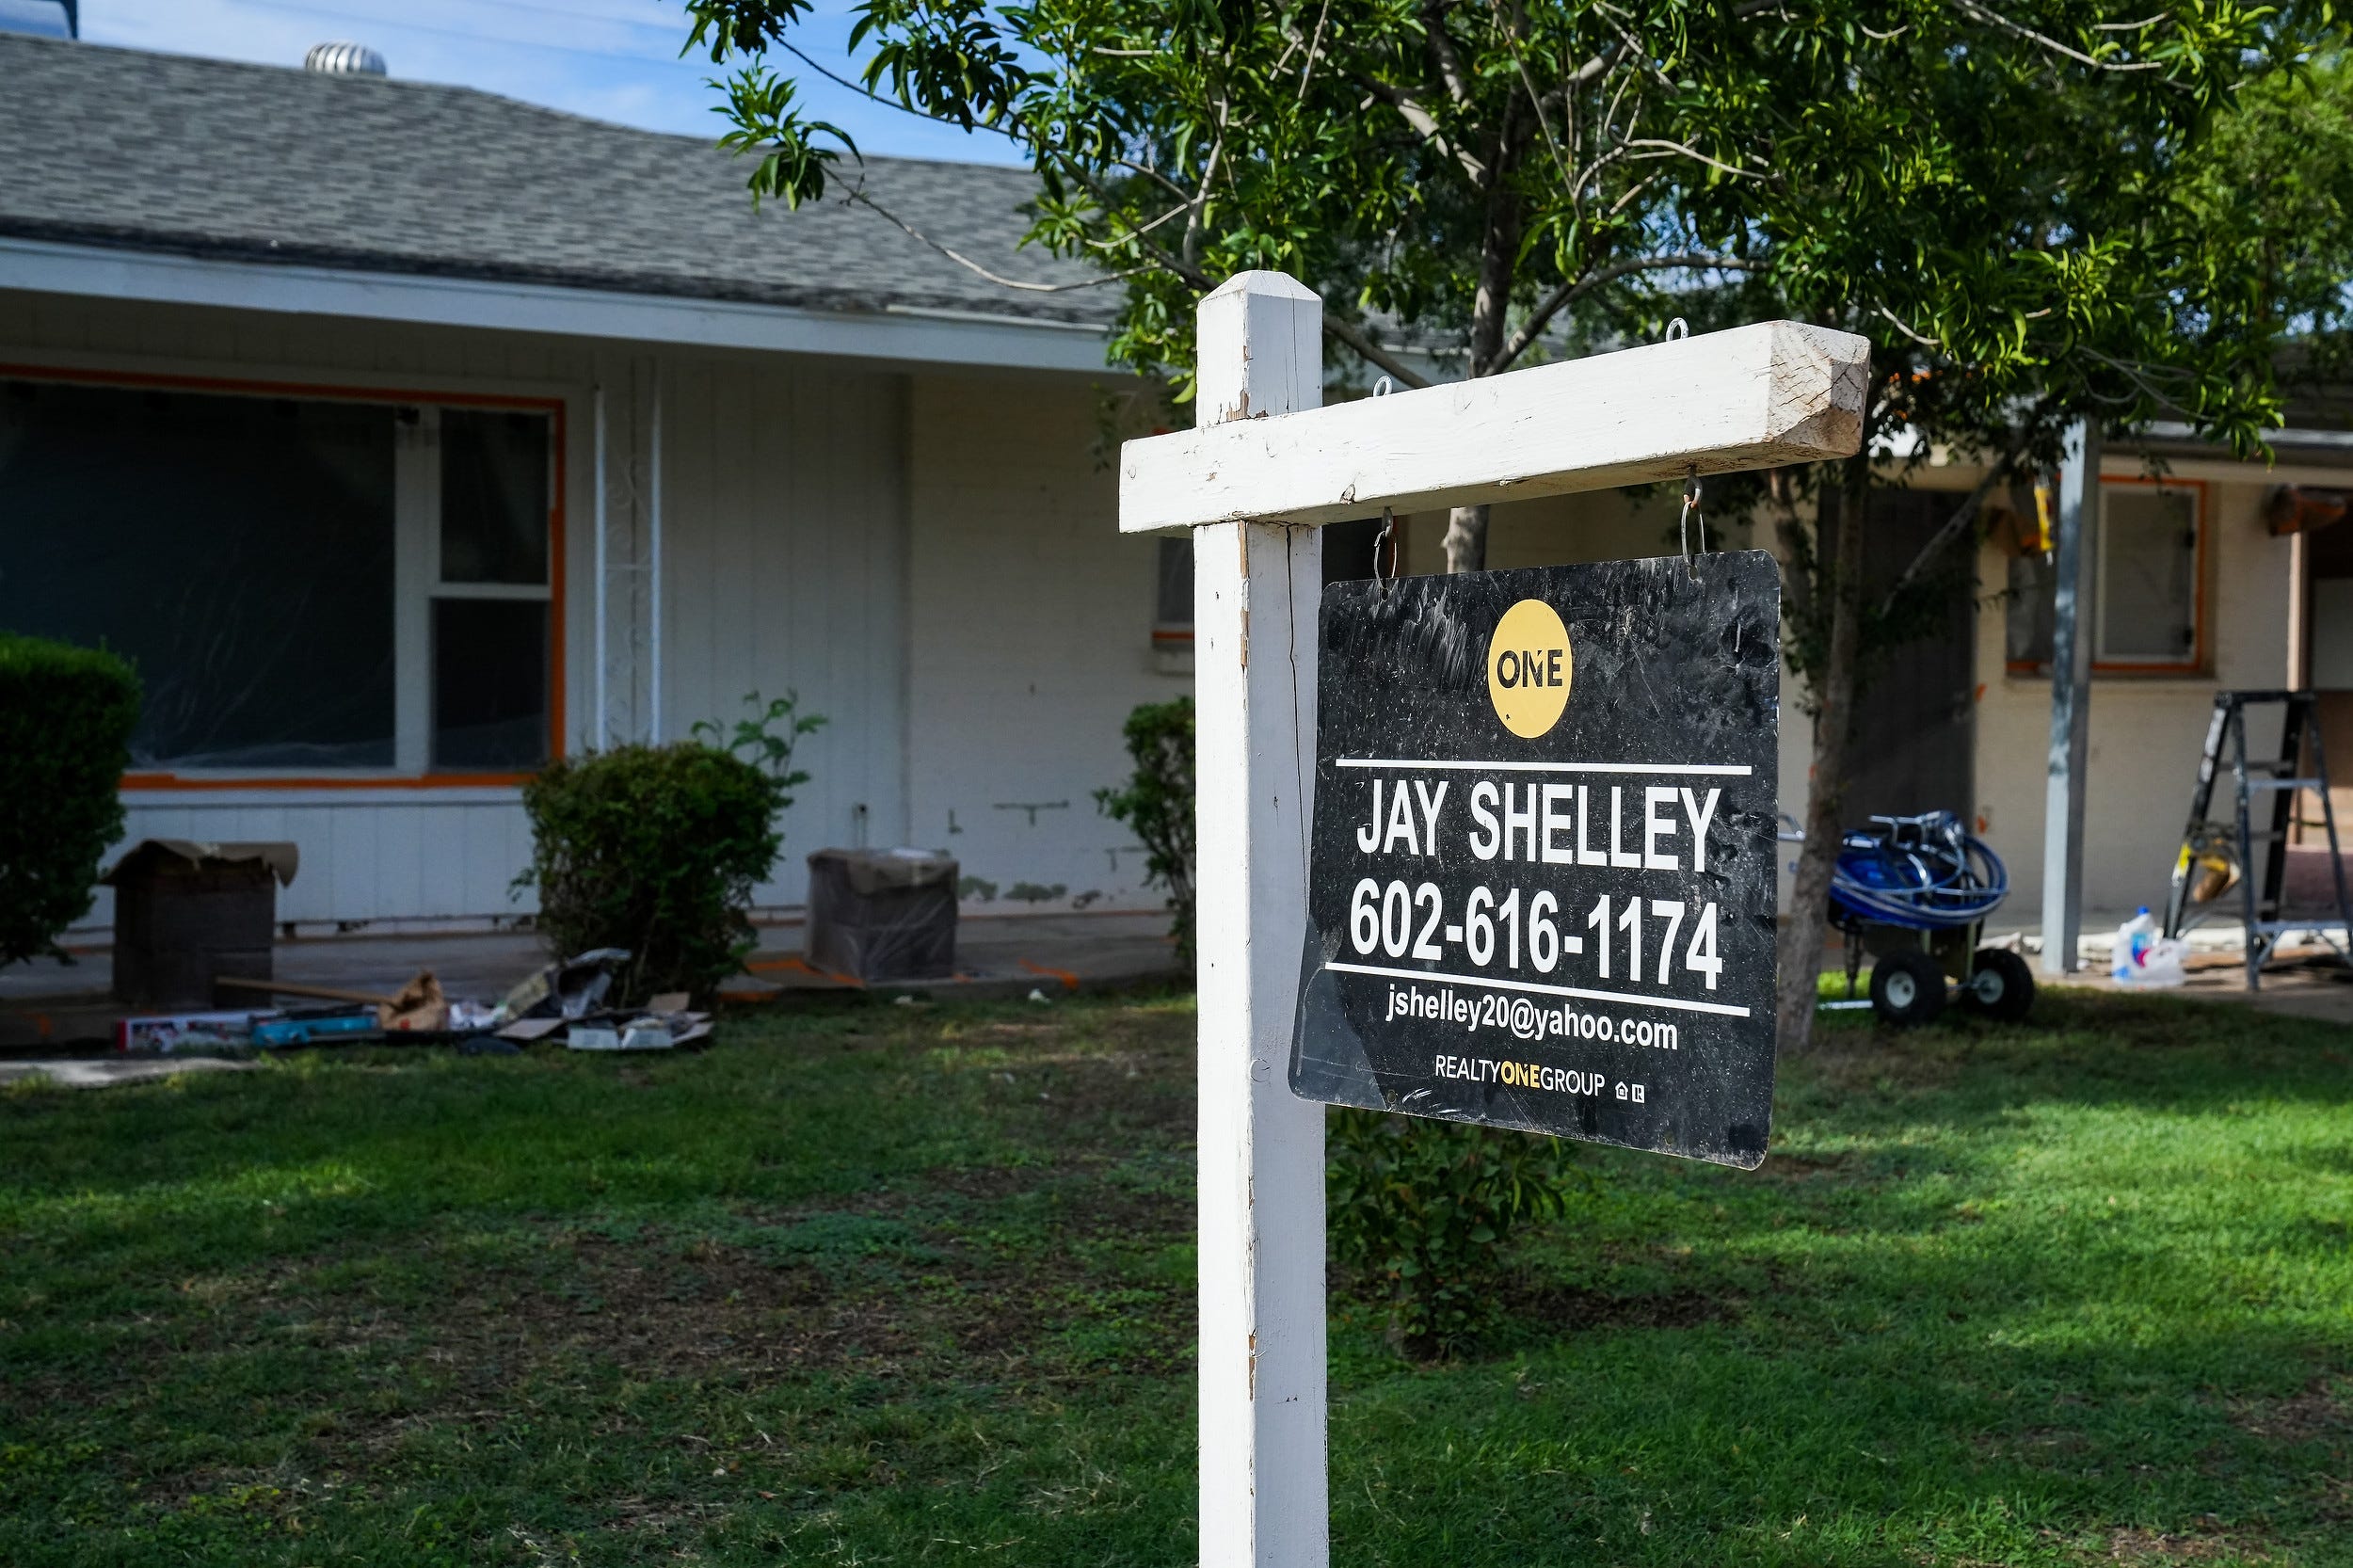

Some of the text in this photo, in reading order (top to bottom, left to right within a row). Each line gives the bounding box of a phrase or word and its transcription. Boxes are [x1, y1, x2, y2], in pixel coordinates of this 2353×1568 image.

[1497, 649, 1563, 688] ONE
[1356, 778, 1721, 872] JAY SHELLEY
[1349, 877, 1723, 990] 602-616-1174
[1385, 984, 1679, 1050] jshelley20@yahoo.com
